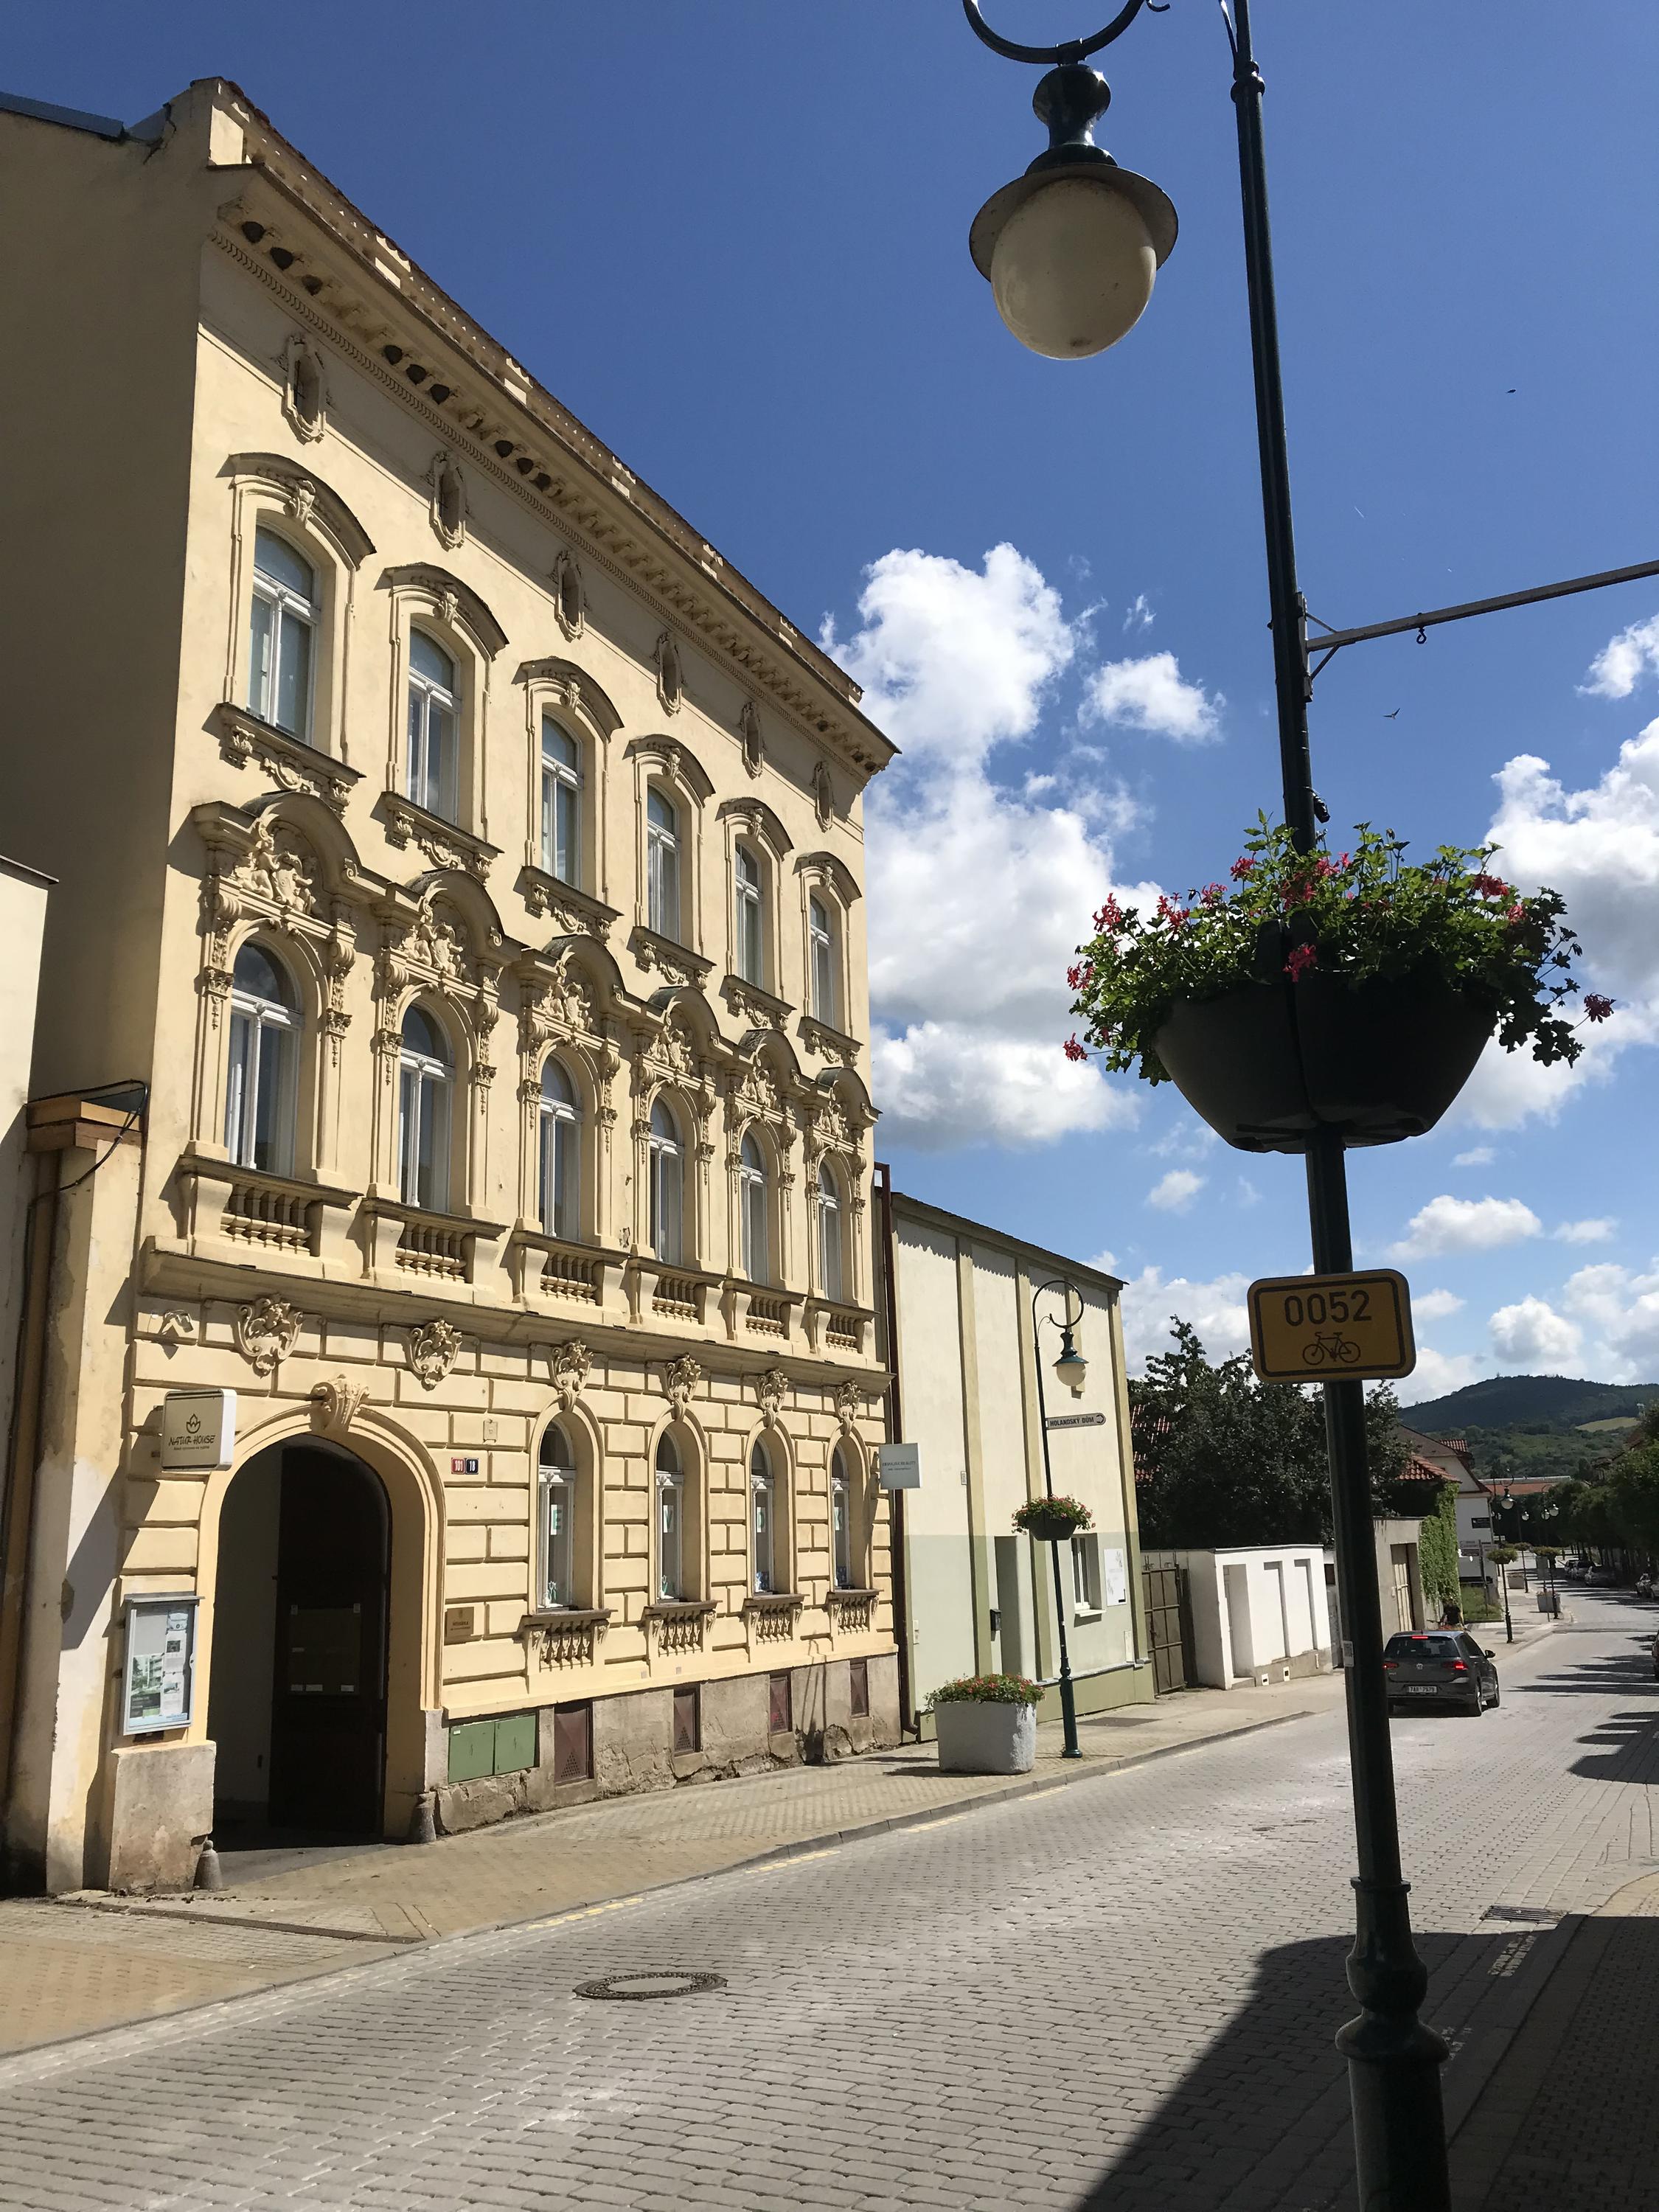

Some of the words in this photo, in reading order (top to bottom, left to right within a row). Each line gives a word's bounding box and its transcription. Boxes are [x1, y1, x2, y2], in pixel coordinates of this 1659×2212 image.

[1284, 1290, 1371, 1326] 0052
[455, 1460, 463, 1471] 101
[469, 1460, 476, 1471] 18
